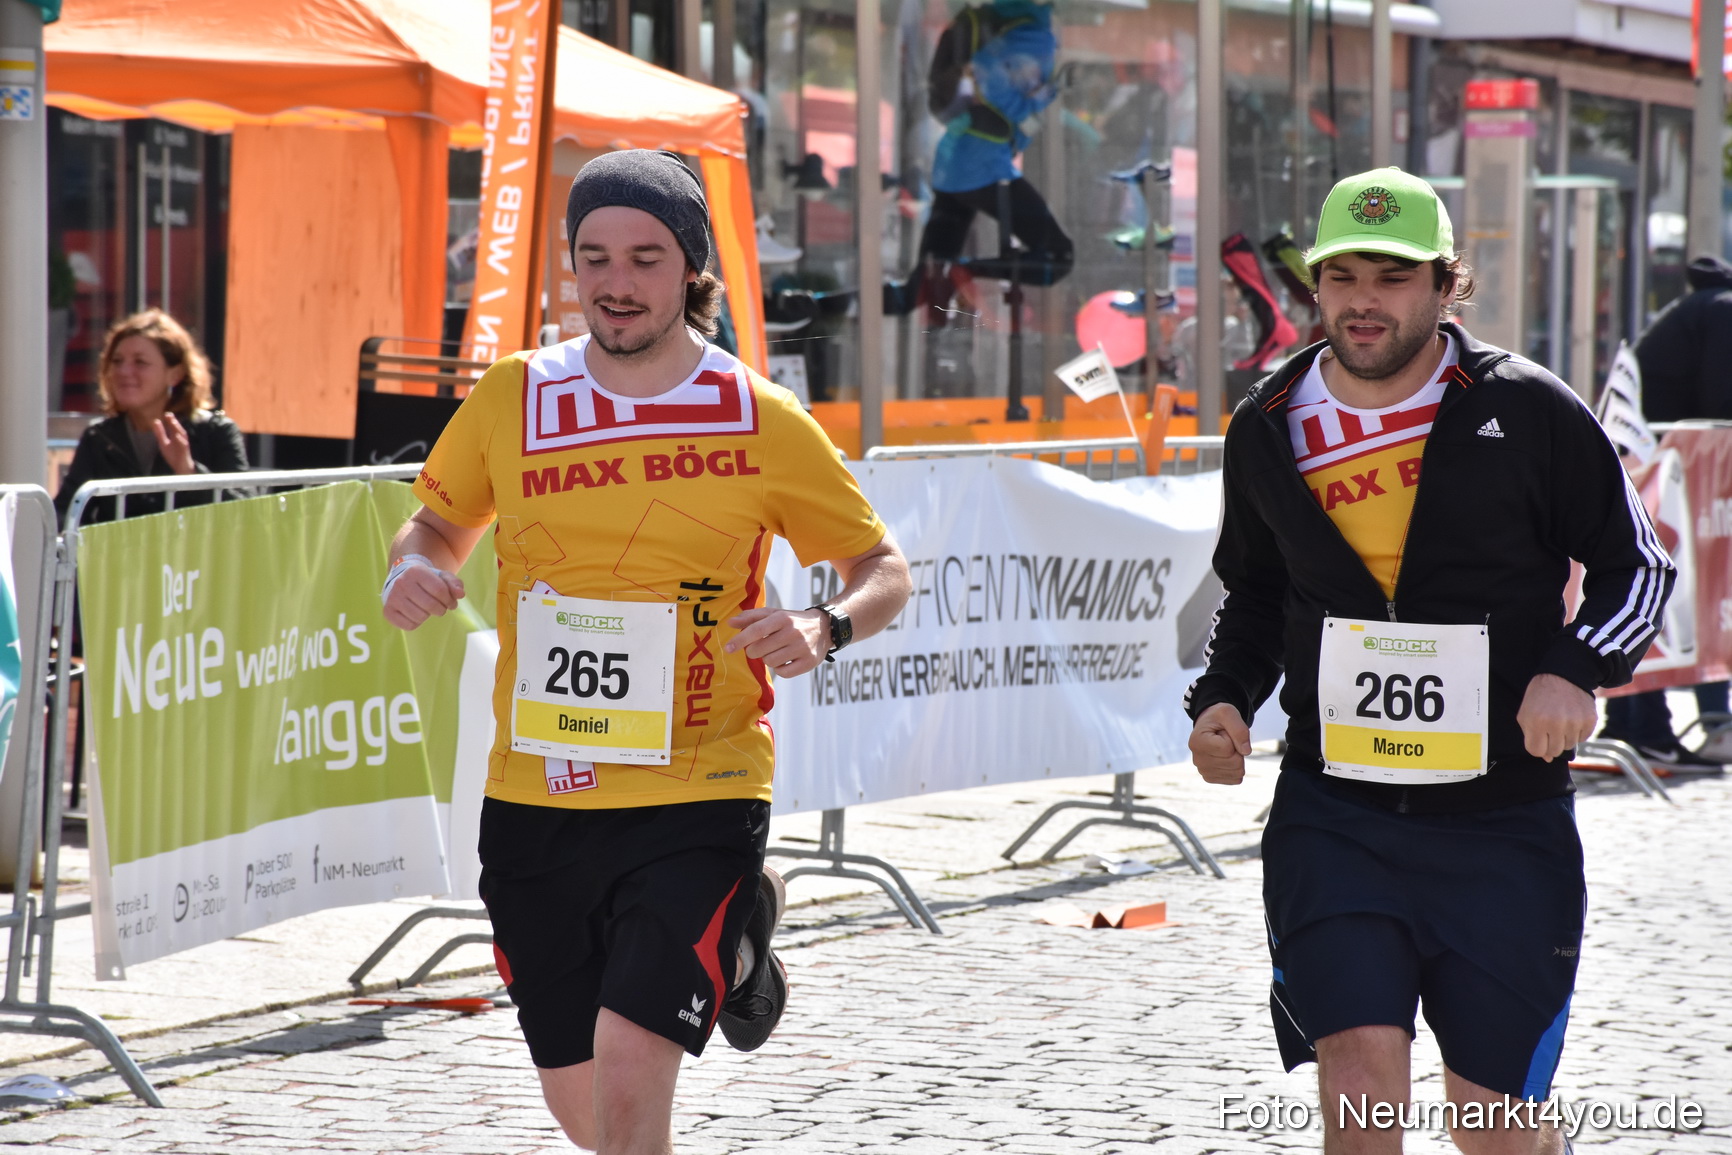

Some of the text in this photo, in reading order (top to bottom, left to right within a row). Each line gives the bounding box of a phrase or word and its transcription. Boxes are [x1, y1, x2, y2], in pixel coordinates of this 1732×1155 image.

[1477, 428, 1505, 438] adidas
[420, 467, 453, 507] egl.de
[521, 444, 761, 498] MAX BÖGL
[162, 563, 199, 618] Der
[569, 612, 624, 630] BOCK
[1379, 637, 1437, 653] BOCK
[112, 612, 371, 719] Neue weiß wo's
[544, 646, 630, 700] 265
[811, 658, 883, 707] WENIGER
[887, 646, 999, 699] VERBRAUCH.
[1355, 671, 1445, 723] 266
[558, 713, 609, 735] Daniel
[1373, 736, 1425, 757] Marco
[678, 1008, 702, 1028] erima
